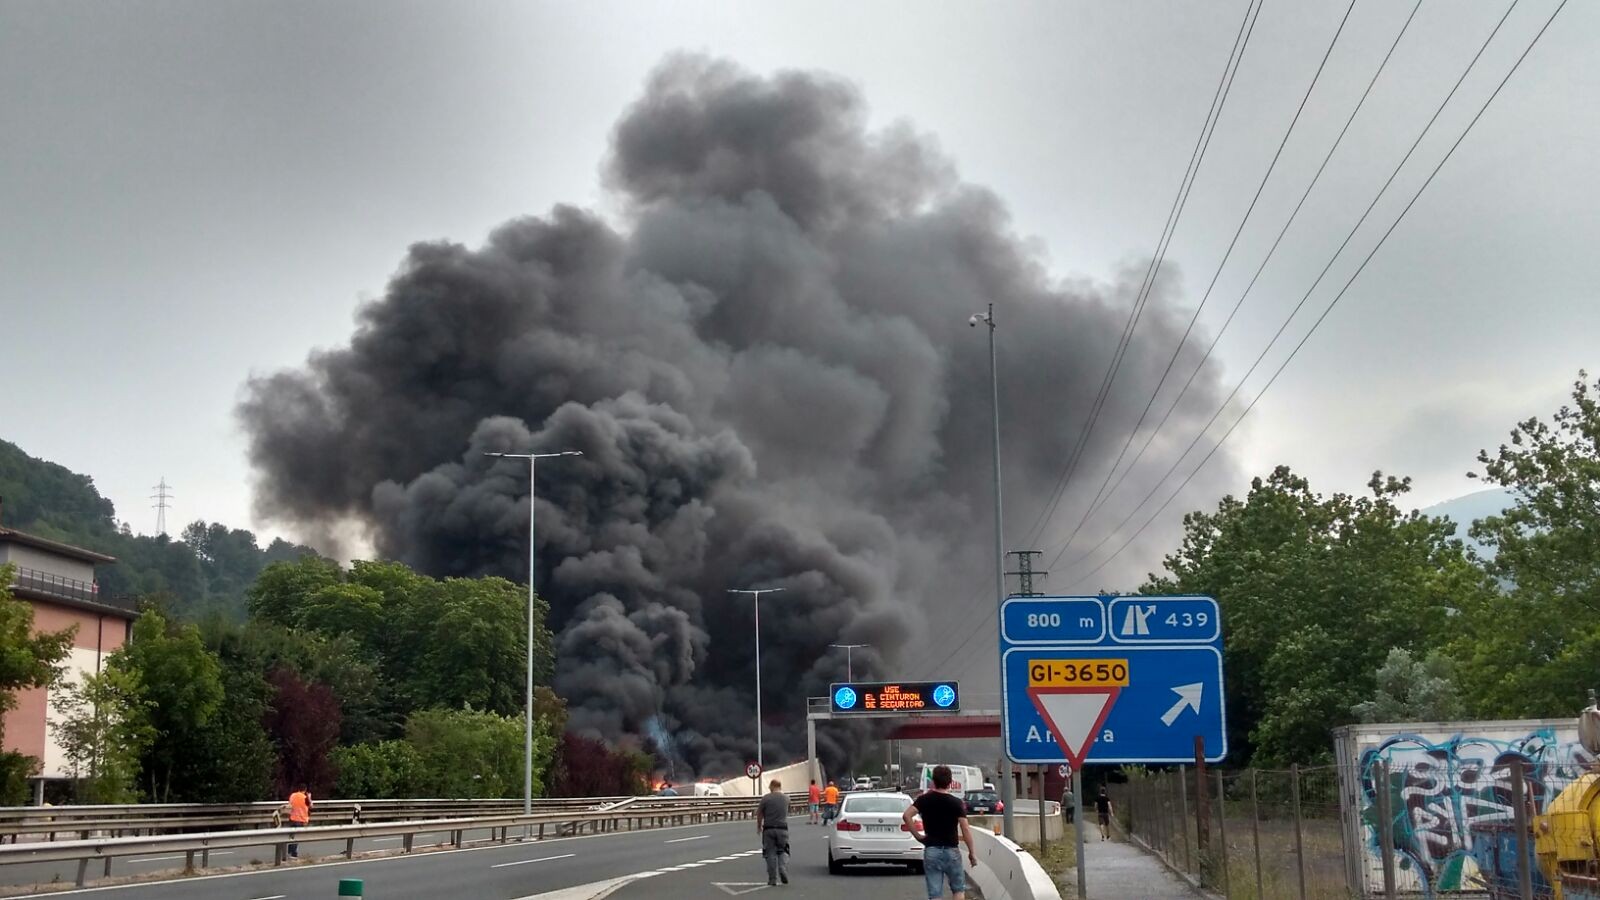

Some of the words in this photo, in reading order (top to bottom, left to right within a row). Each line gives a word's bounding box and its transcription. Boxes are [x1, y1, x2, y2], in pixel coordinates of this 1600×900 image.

[1027, 614, 1061, 628] 800
[1080, 618, 1094, 628] m
[1165, 613, 1209, 627] 439
[1031, 664, 1126, 682] GI-3650
[879, 693, 920, 701] CINTURON
[865, 701, 876, 709] DE
[880, 700, 925, 709] SEGURIDAD
